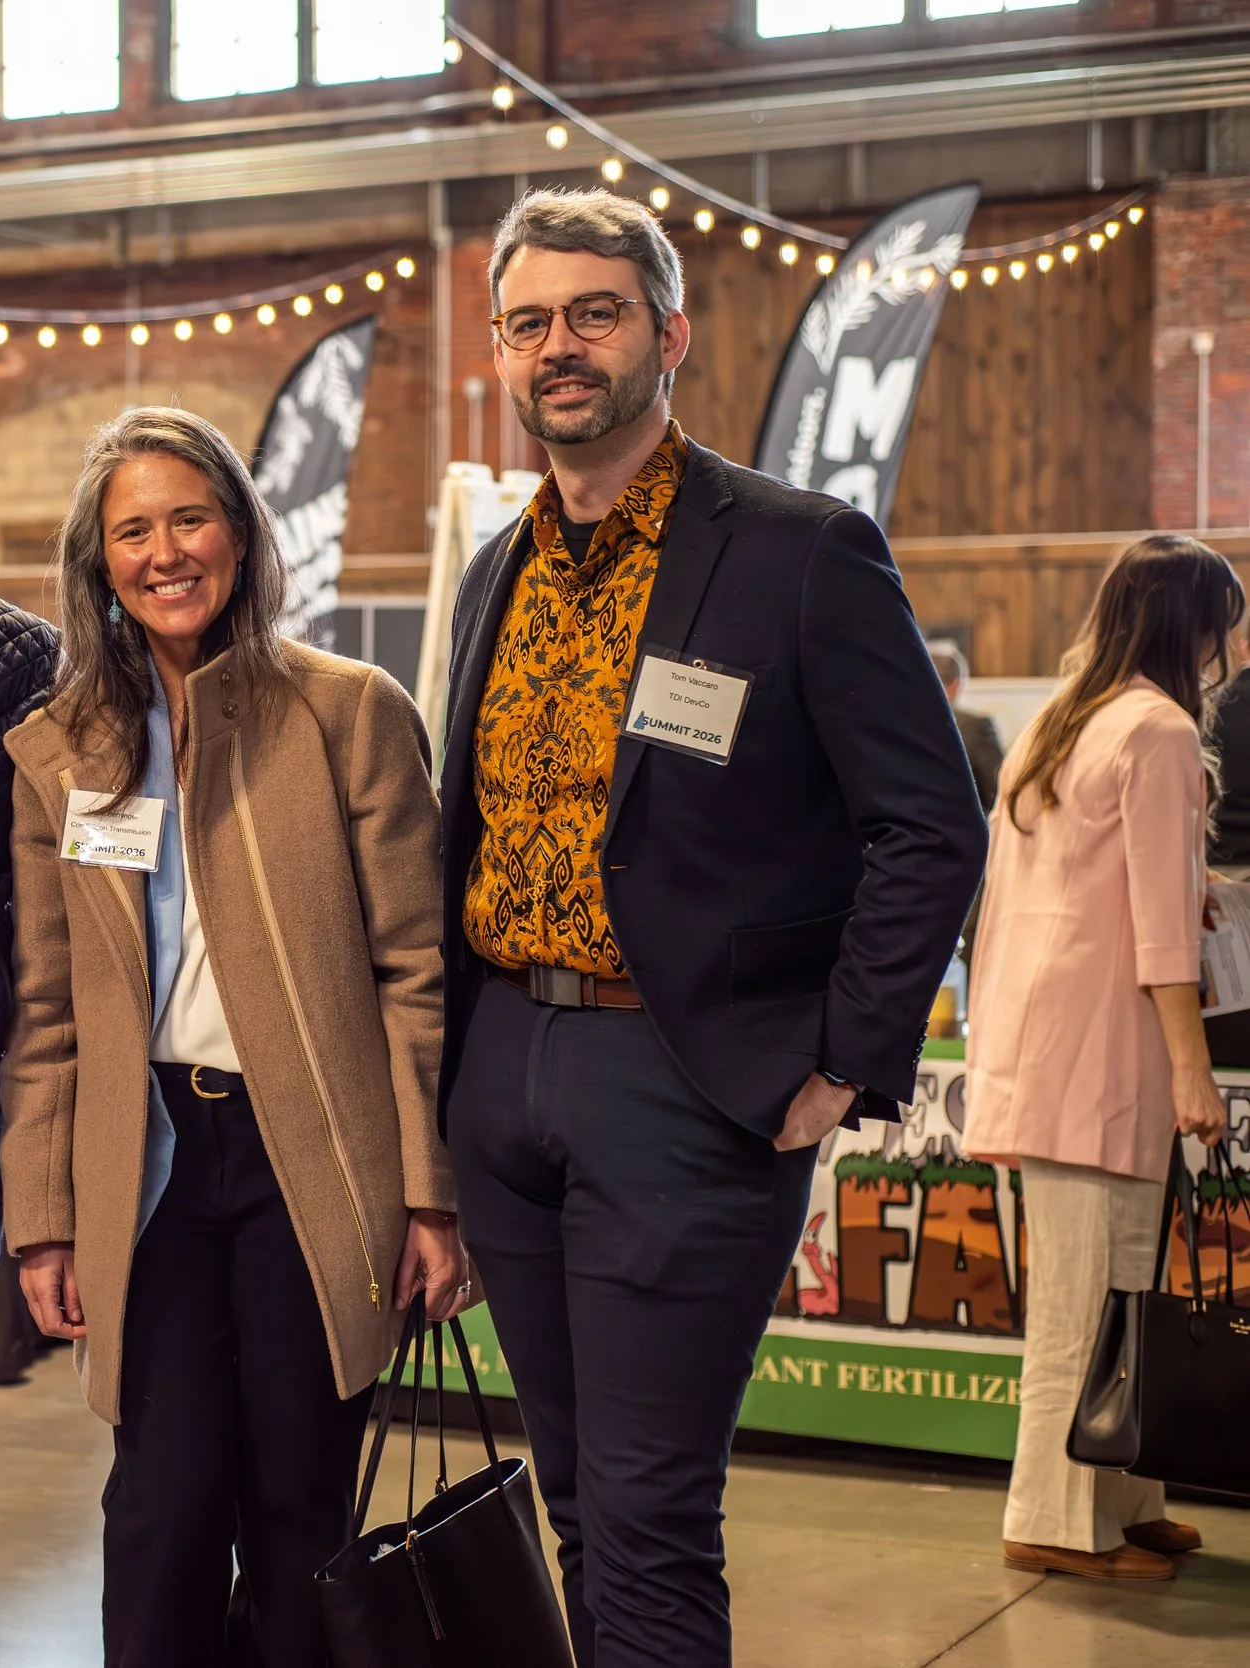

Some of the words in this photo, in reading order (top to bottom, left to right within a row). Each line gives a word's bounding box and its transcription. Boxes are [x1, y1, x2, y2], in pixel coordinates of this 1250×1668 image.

[671, 672, 687, 683] Tom
[688, 676, 719, 691] Vaccaro
[669, 692, 683, 702] TDI
[684, 696, 710, 709] DevCo
[642, 716, 691, 736] SUMMIT
[692, 729, 723, 744] 2026
[110, 825, 152, 836] Transmission
[119, 846, 146, 857] 2026
[754, 1353, 829, 1389] ANT
